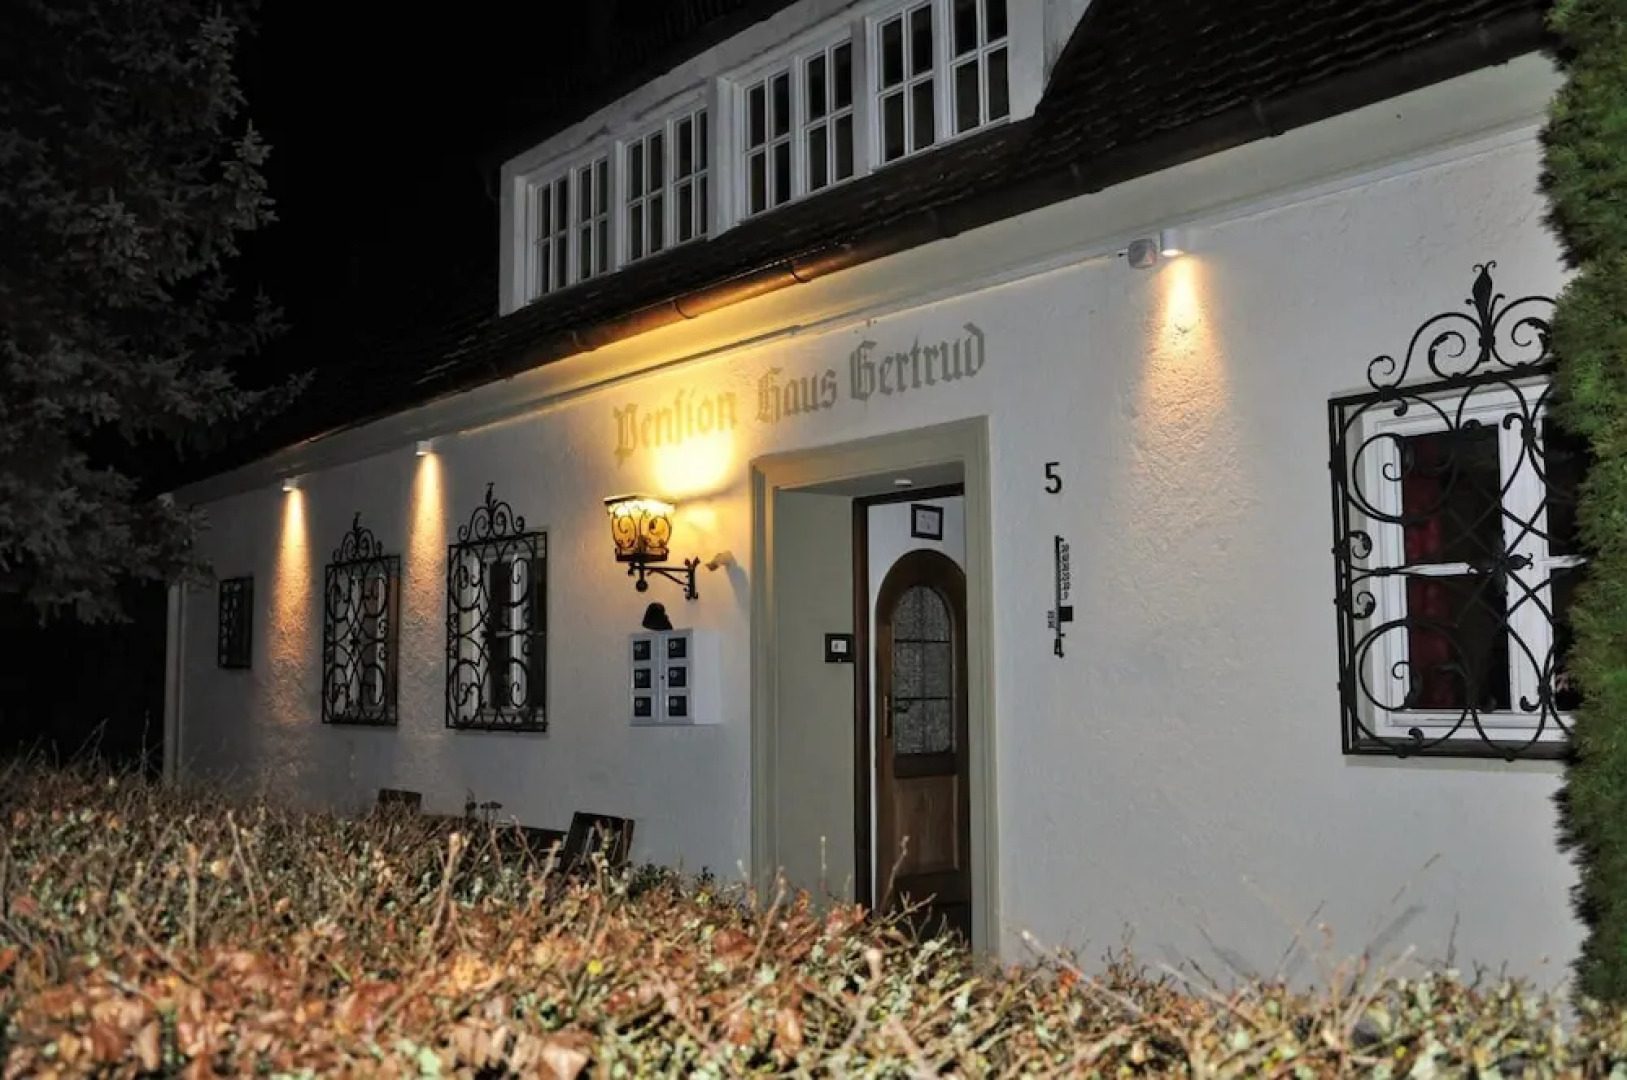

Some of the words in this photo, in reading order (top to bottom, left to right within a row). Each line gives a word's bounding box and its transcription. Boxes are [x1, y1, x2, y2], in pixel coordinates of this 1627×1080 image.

[755, 367, 838, 424] Haus
[849, 322, 985, 400] Gertrud
[1045, 462, 1062, 494] 5
